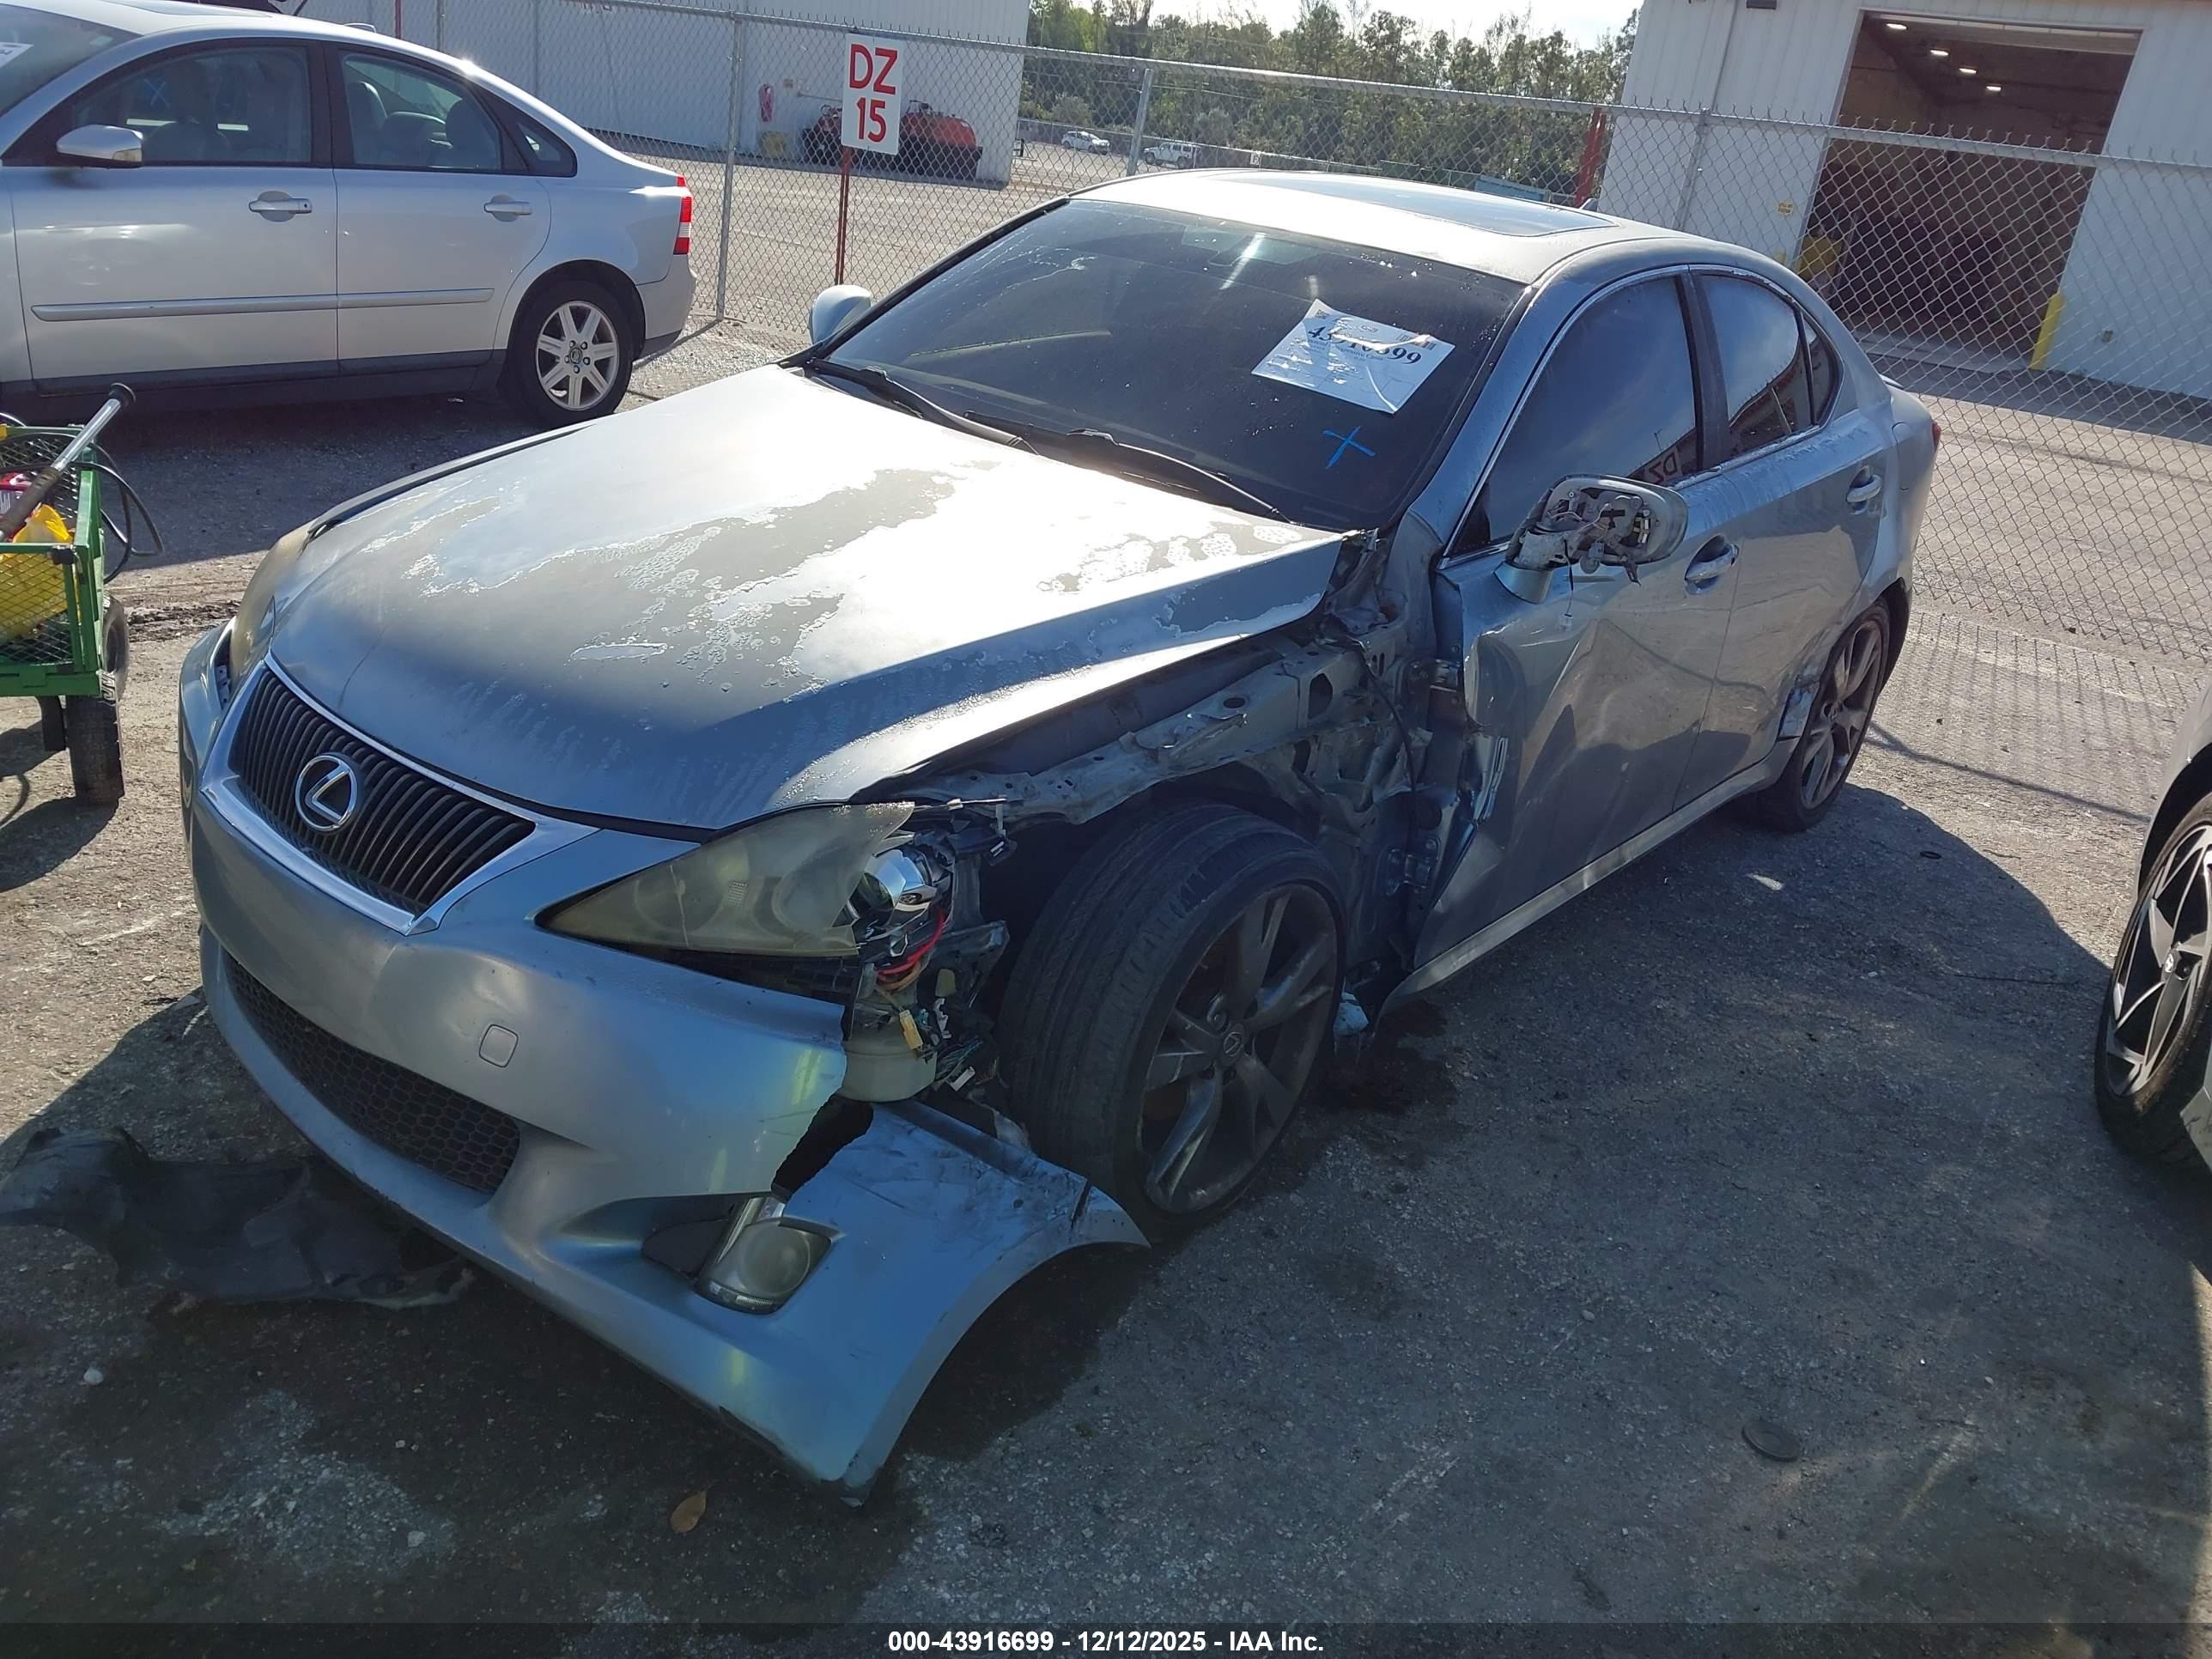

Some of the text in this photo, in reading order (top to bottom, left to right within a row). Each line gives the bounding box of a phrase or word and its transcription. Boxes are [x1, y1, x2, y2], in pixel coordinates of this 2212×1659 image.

[849, 43, 898, 95] DZ
[856, 97, 887, 143] 15
[1308, 325, 1422, 365] 4399
